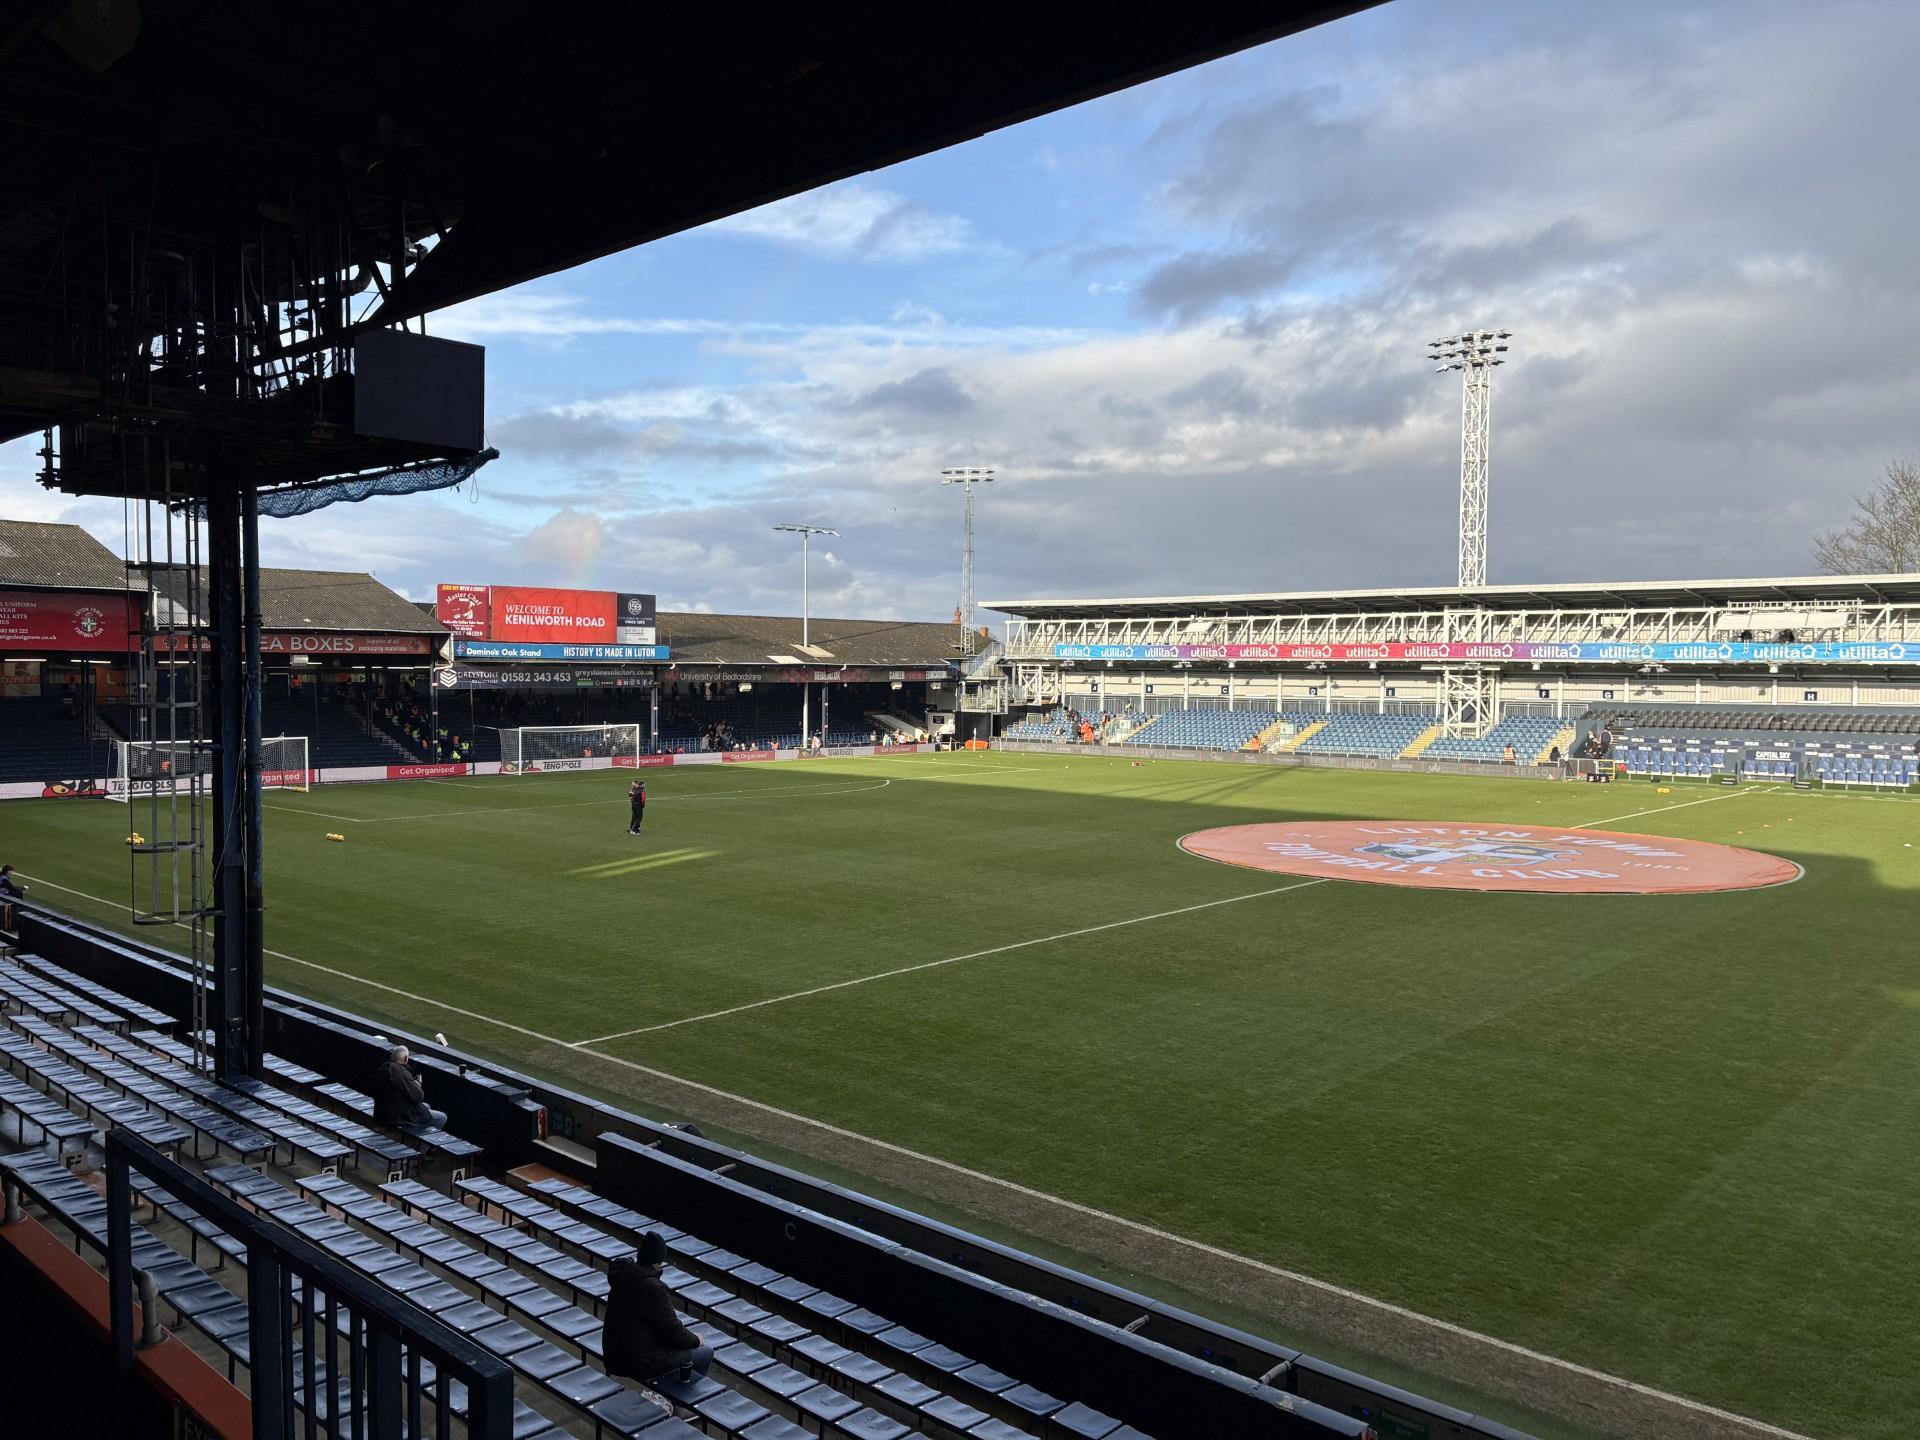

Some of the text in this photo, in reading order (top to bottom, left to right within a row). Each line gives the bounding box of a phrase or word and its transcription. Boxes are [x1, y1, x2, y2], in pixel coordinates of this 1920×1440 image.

[445, 593, 467, 604] Master
[505, 604, 564, 615] WELCOME TO
[505, 615, 573, 627] KENILWORTH
[576, 617, 606, 627] ROAD
[290, 636, 354, 652] BOXES
[466, 648, 542, 657] Domino's Oak Stand
[563, 647, 656, 657] HISTORY IS MADE IN LUTON
[1059, 646, 1083, 657] utilita
[1100, 646, 1125, 657] utilita
[1144, 646, 1170, 657] utilita
[1190, 646, 1218, 657] utilita
[1239, 646, 1269, 657] utilita
[1291, 646, 1322, 658] utilita
[1345, 646, 1379, 658] utilita
[1404, 645, 1439, 658] utilita
[1465, 645, 1502, 658] utilita
[1530, 645, 1569, 658] utilita
[1673, 645, 1718, 659] utilita
[1753, 645, 1801, 660] utilita
[1839, 645, 1889, 660] utilita
[457, 671, 499, 679] GREYSTONE
[501, 672, 571, 683] 01582 343 453
[575, 668, 654, 677] greystonesolicitors.co.uk
[680, 672, 714, 681] University
[714, 672, 721, 680] of
[722, 672, 762, 681] Bedfordshire
[400, 765, 455, 776] Get Organised
[1355, 828, 1687, 857] LUTON TOWN
[1263, 842, 1620, 880] FOOTBALL CLUB
[454, 1170, 463, 1182] A
